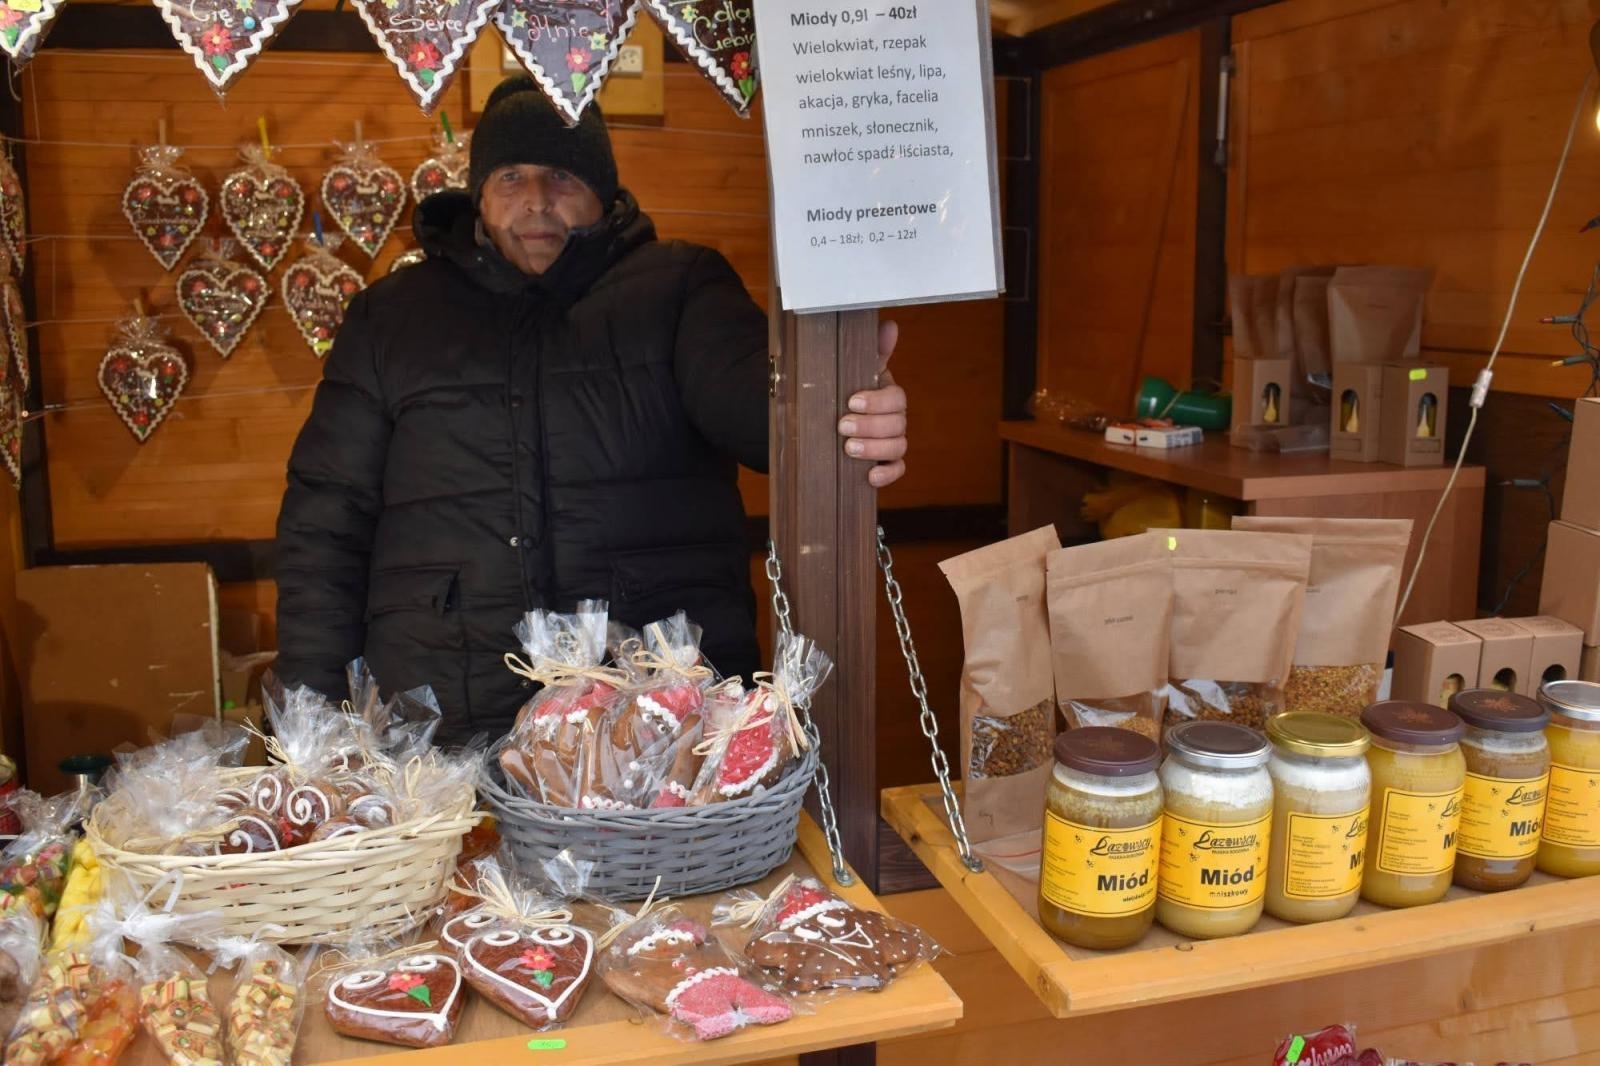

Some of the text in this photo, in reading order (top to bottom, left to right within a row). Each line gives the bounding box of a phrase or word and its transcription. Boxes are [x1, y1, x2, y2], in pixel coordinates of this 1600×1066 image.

[714, 1, 752, 21] dla
[790, 12, 837, 28] Miody
[841, 9, 868, 24] 0,9l
[888, 6, 917, 20] 40zł
[793, 36, 927, 55] Wielokwiat, rzepak
[796, 64, 946, 84] wielokwiat leśny, lipa,
[799, 90, 938, 110] akacja, gryka, facelia
[802, 119, 938, 138] mniszek, słonecznik,
[804, 144, 954, 164] nawłoć spadź liściasta,
[807, 203, 936, 222] Miody prezentowe
[811, 236, 826, 248] 0,4
[840, 232, 864, 245] 18zł;
[869, 232, 884, 243] 0,2
[898, 229, 917, 240] 12zł
[1098, 869, 1149, 891] Miód
[1200, 864, 1255, 886] Miód
[1210, 889, 1249, 898] mniszkowy
